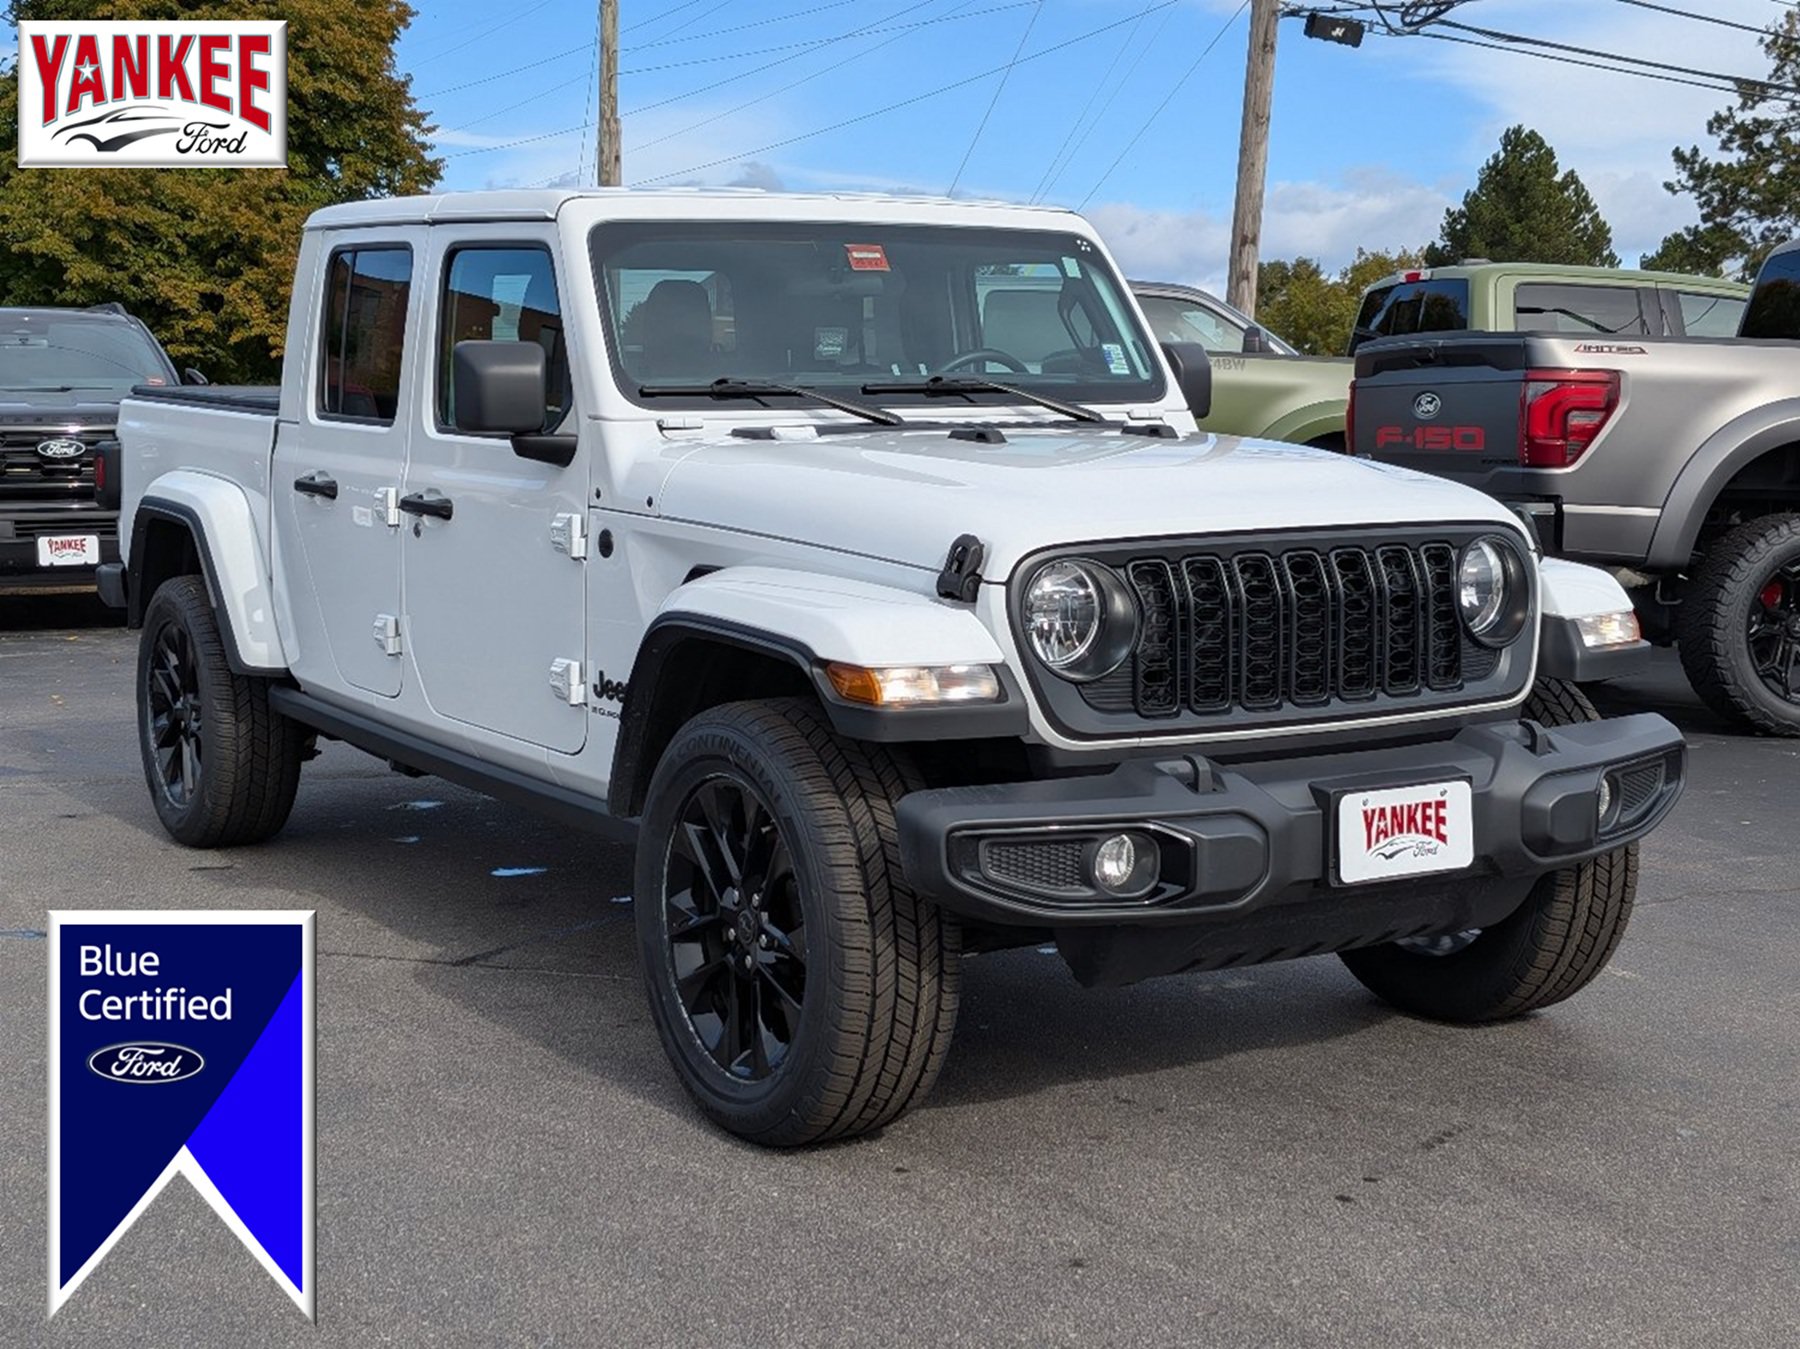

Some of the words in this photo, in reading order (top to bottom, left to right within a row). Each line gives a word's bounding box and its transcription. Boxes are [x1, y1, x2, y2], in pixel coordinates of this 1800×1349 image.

[1376, 425, 1485, 450] F-150
[46, 441, 77, 455] Ford
[48, 538, 87, 554] YANKEE
[1362, 800, 1447, 853] YANKEE
[1413, 840, 1440, 858] Ford
